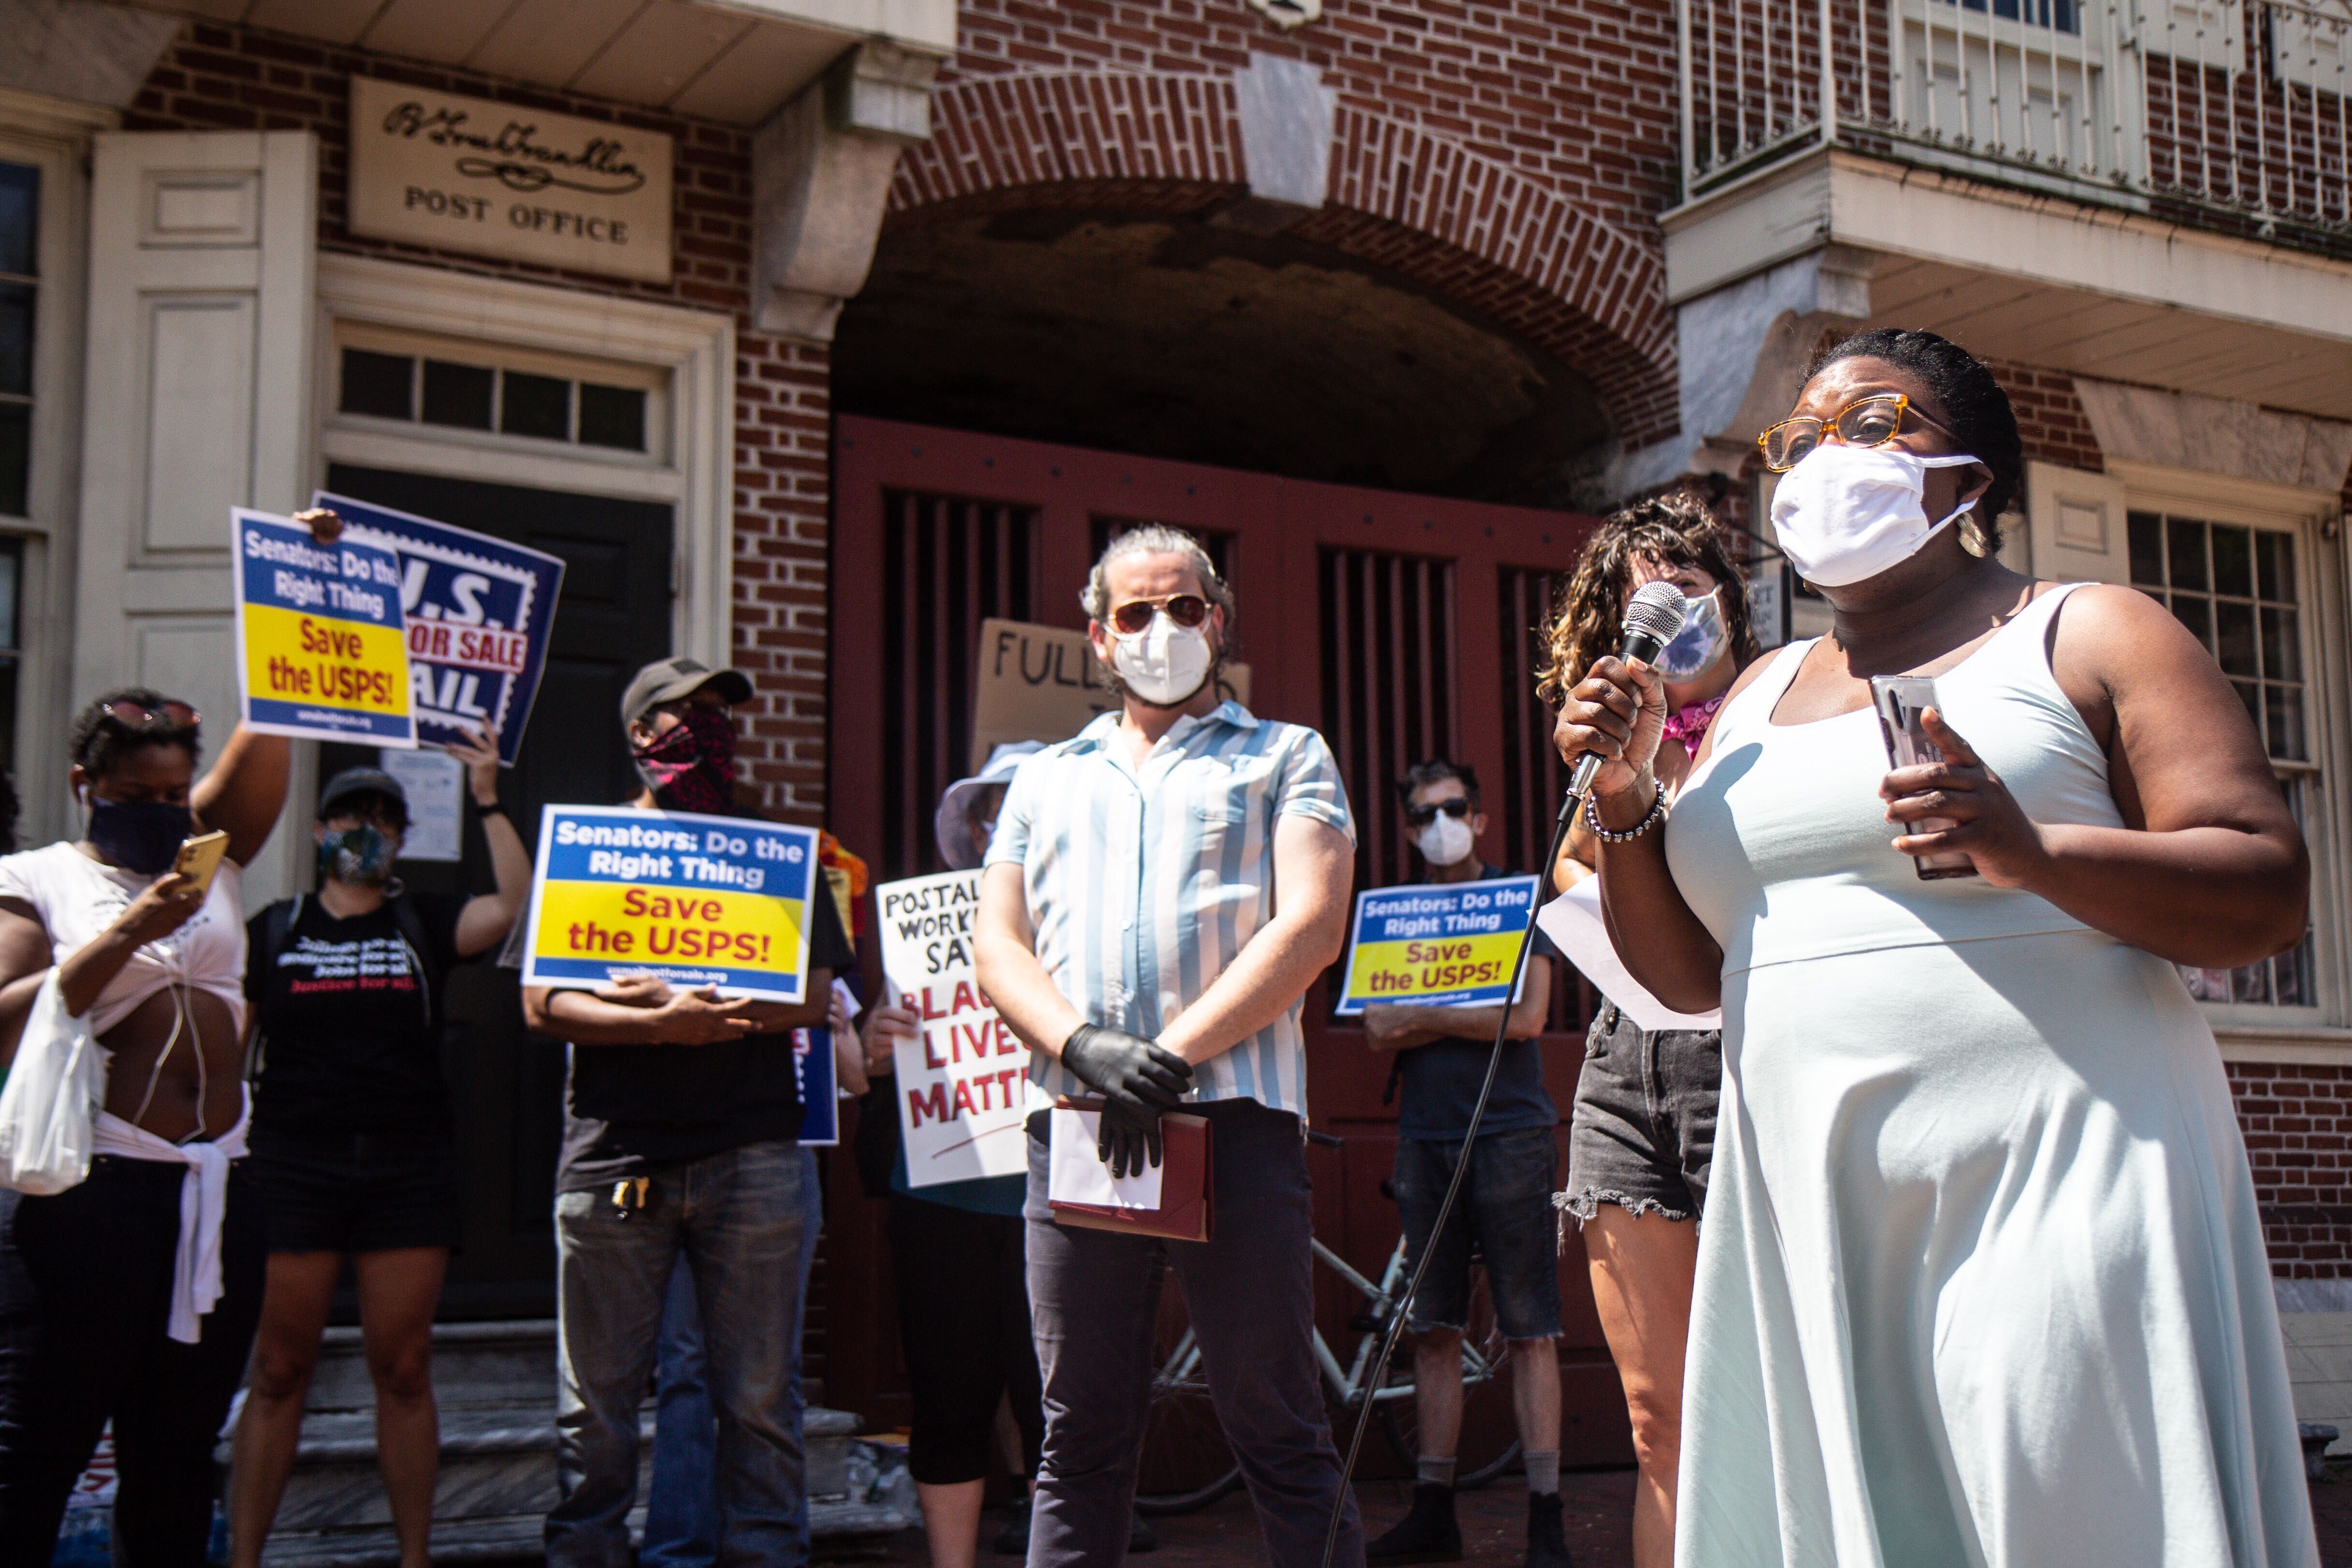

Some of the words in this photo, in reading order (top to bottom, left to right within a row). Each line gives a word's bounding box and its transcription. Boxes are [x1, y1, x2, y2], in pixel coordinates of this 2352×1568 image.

[405, 186, 493, 222] POST
[508, 204, 628, 244] OFFICE
[244, 529, 338, 575] Senators:
[341, 550, 372, 580] Do
[372, 557, 400, 587] the
[274, 569, 326, 607] Right
[326, 582, 385, 621] Thing
[300, 617, 364, 659] Save
[408, 624, 451, 657] OR
[459, 630, 523, 667] SALE
[268, 655, 312, 695] the
[317, 662, 394, 706] USPS!
[412, 662, 487, 716] AIL
[556, 821, 699, 851] Senators:
[706, 831, 748, 855] Do
[755, 837, 804, 864] the
[589, 850, 672, 880] Right
[679, 855, 765, 890] Thing
[623, 889, 724, 923] Save
[885, 879, 979, 919] POSTAL
[1364, 896, 1457, 918] Senators:
[1461, 893, 1491, 910] Do
[1495, 889, 1528, 906] the
[568, 922, 635, 953] the
[648, 926, 772, 963] USPS!
[898, 907, 978, 941] WORK
[1384, 917, 1440, 937] Right
[1445, 913, 1501, 931] Thing
[926, 935, 974, 974] SA
[1405, 941, 1472, 964] Save
[1370, 968, 1413, 992] the
[1421, 960, 1502, 988] USPS!
[923, 1016, 1032, 1070] LIVE
